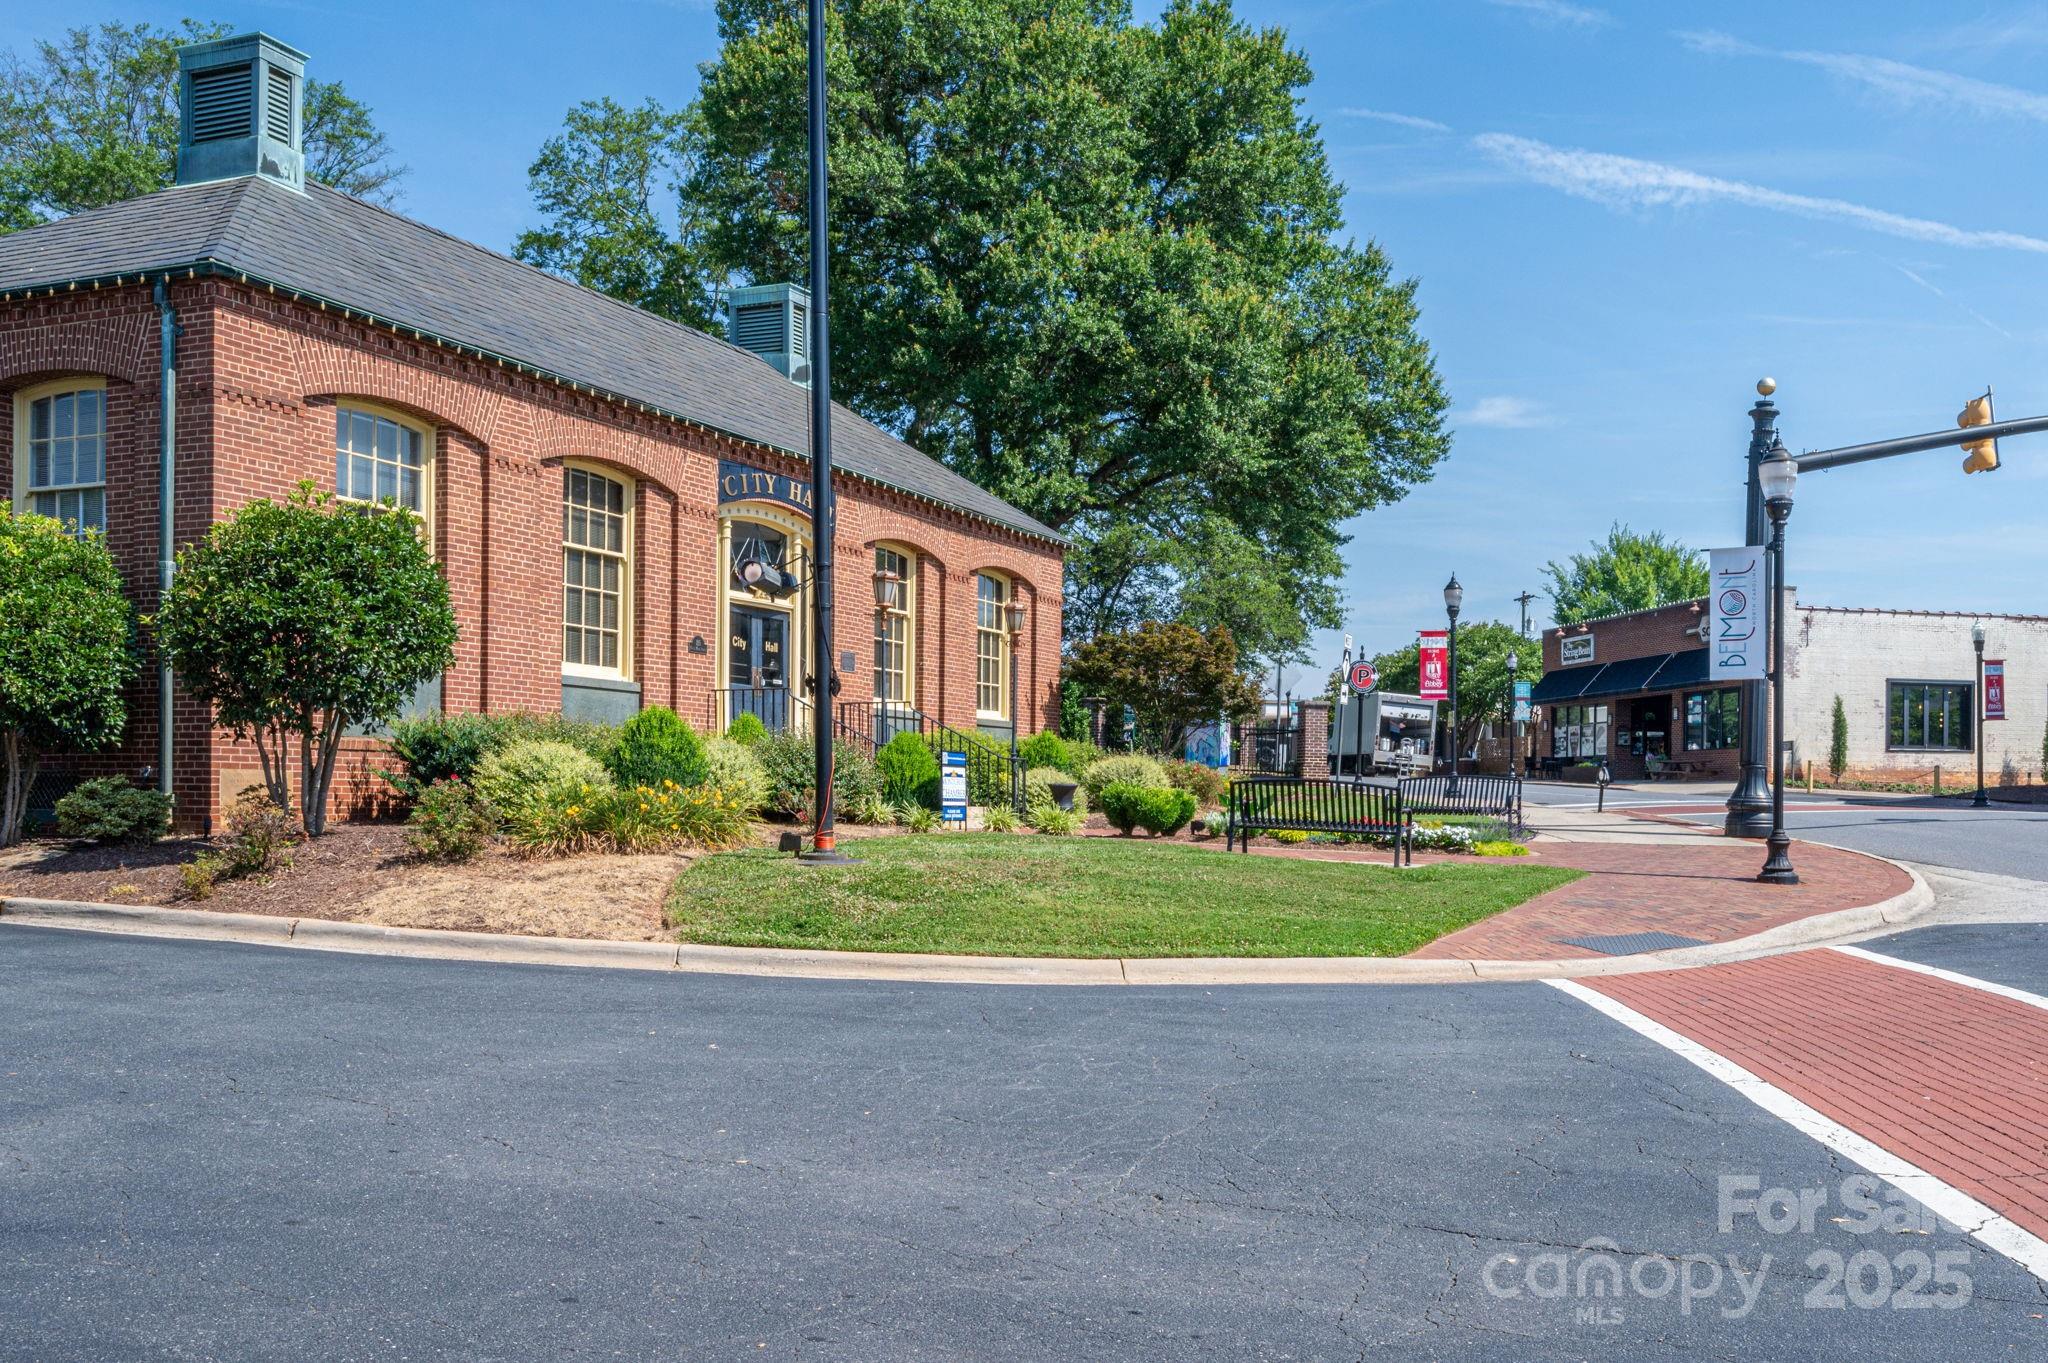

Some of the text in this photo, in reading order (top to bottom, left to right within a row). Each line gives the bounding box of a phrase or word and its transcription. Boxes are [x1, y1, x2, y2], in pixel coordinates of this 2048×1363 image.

[724, 473, 777, 496] CITY
[732, 635, 779, 653] City Hall
[1357, 668, 1371, 684] P
